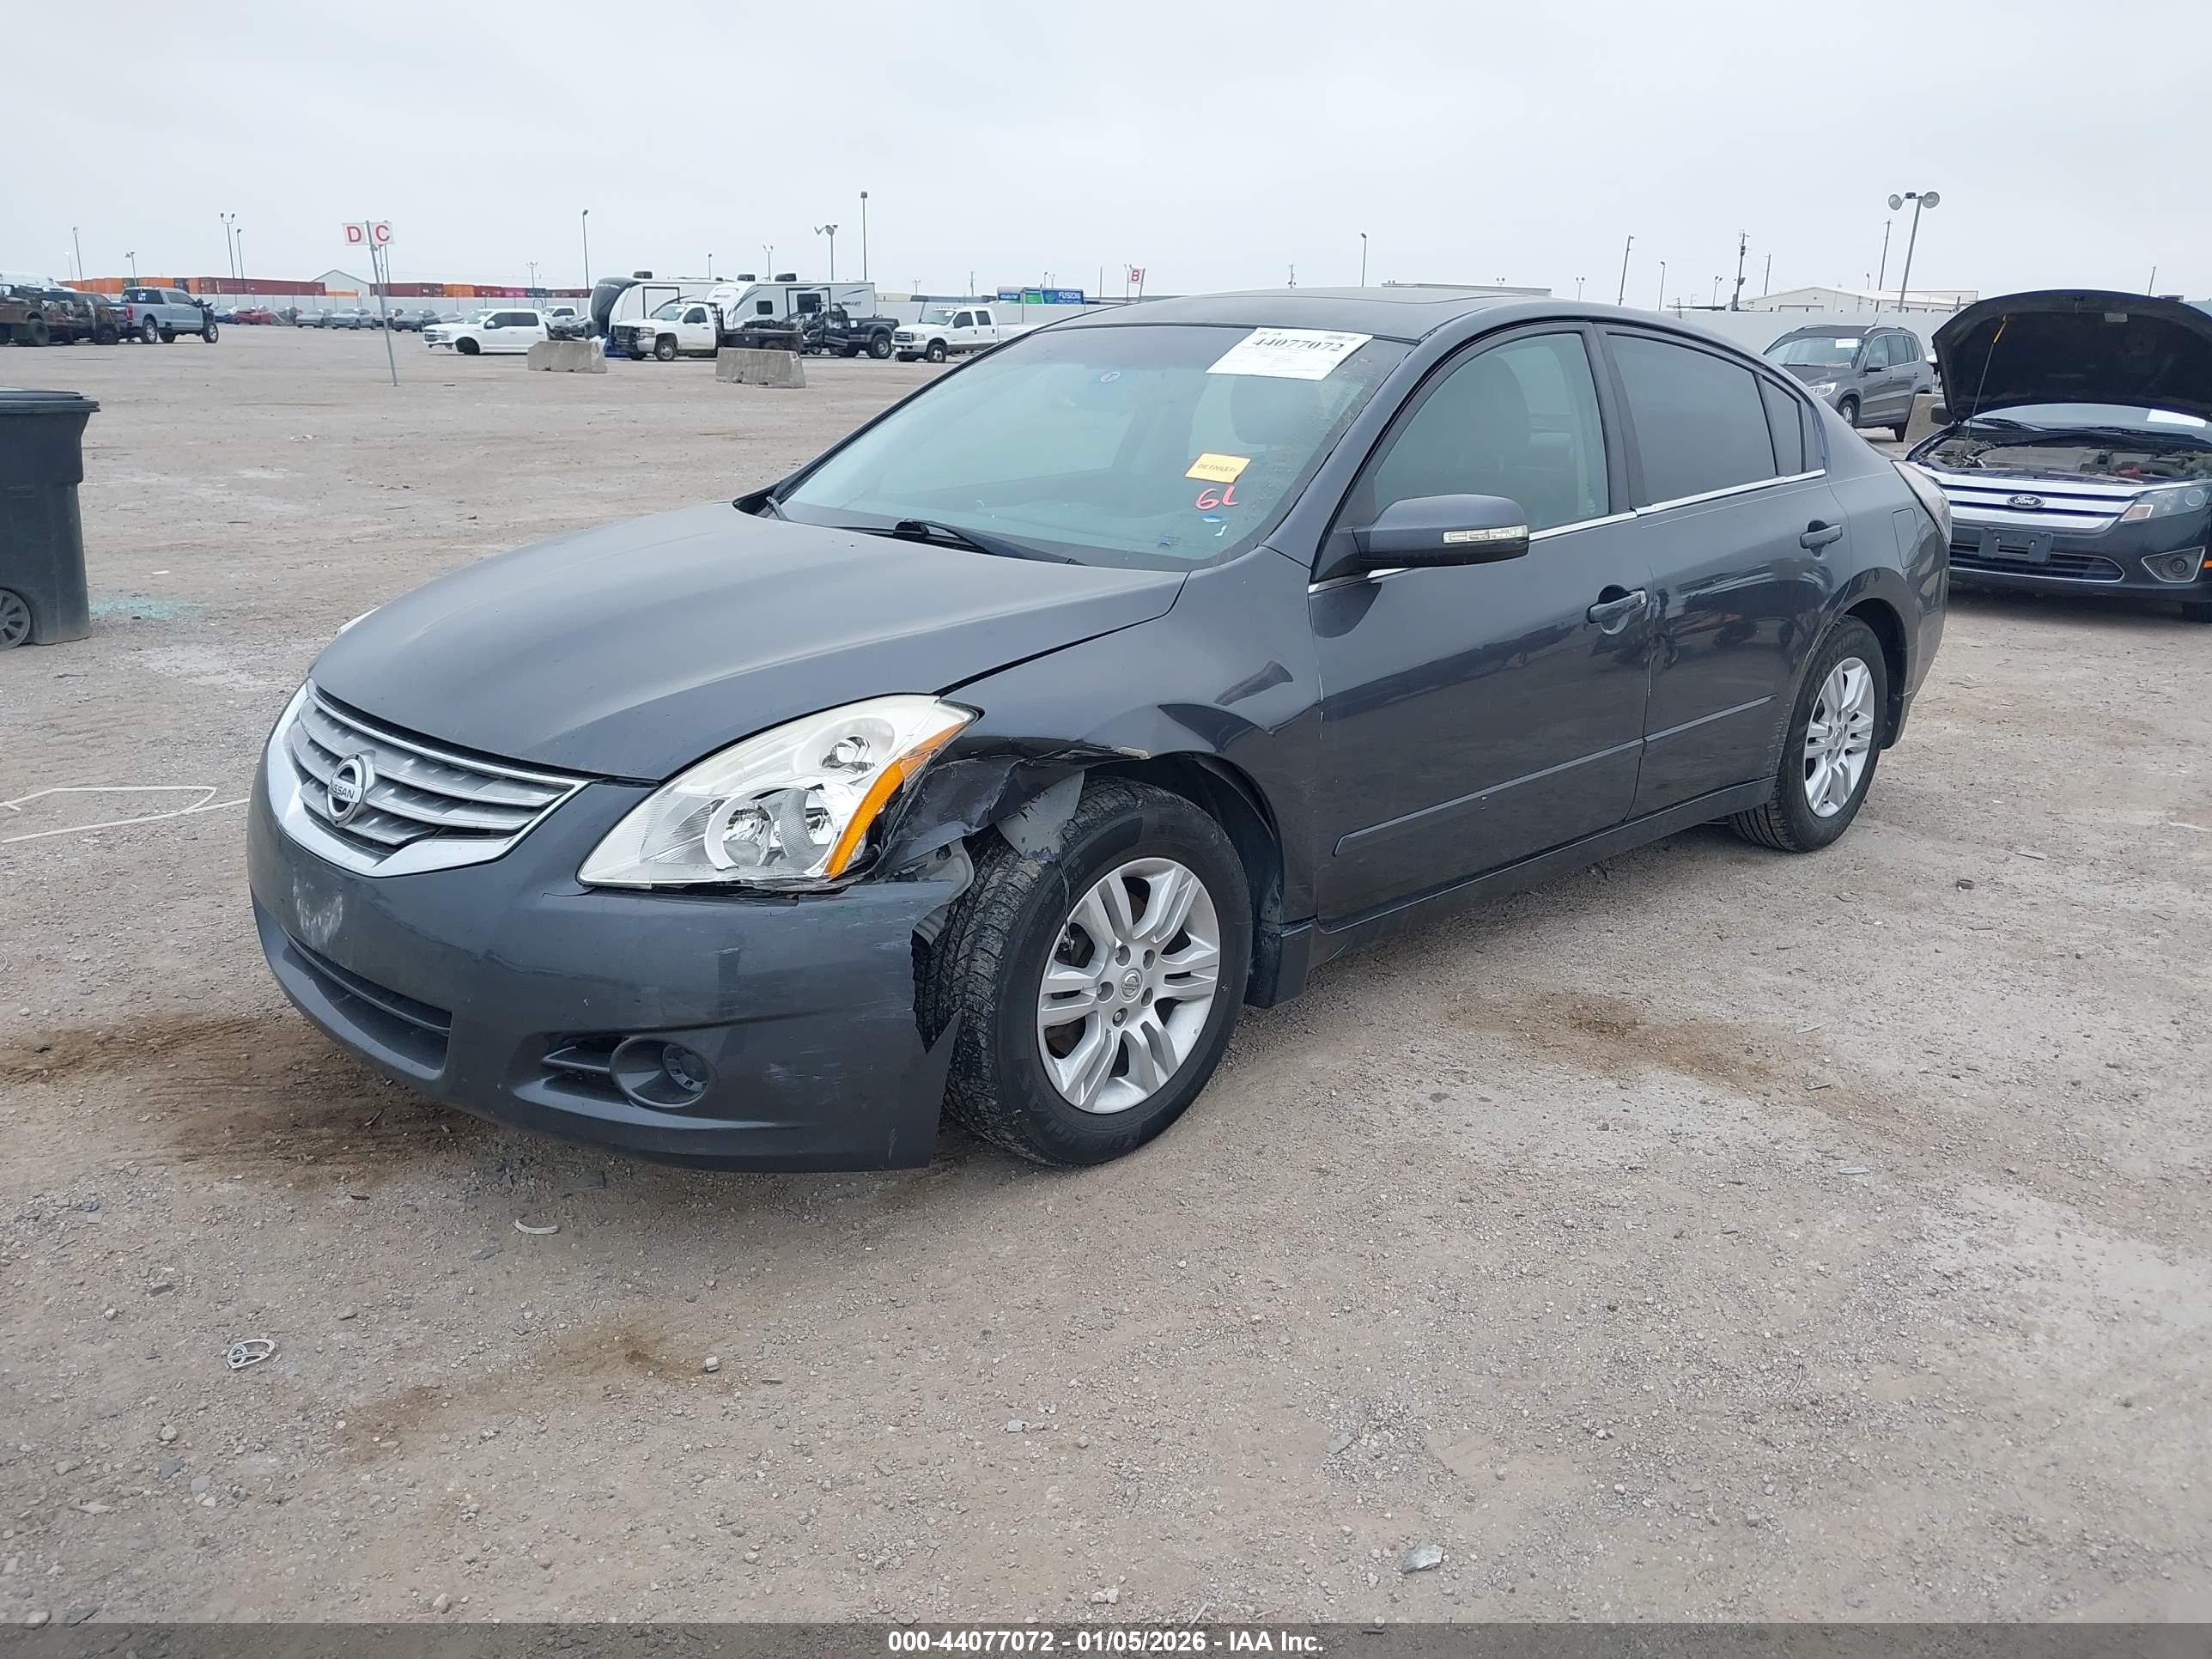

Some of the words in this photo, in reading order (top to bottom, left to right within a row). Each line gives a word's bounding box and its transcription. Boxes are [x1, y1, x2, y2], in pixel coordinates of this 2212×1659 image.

[346, 226, 362, 242] D
[375, 224, 390, 242] C
[1131, 270, 1140, 282] B
[1252, 337, 1345, 352] 44077072
[2014, 495, 2037, 505] Ford
